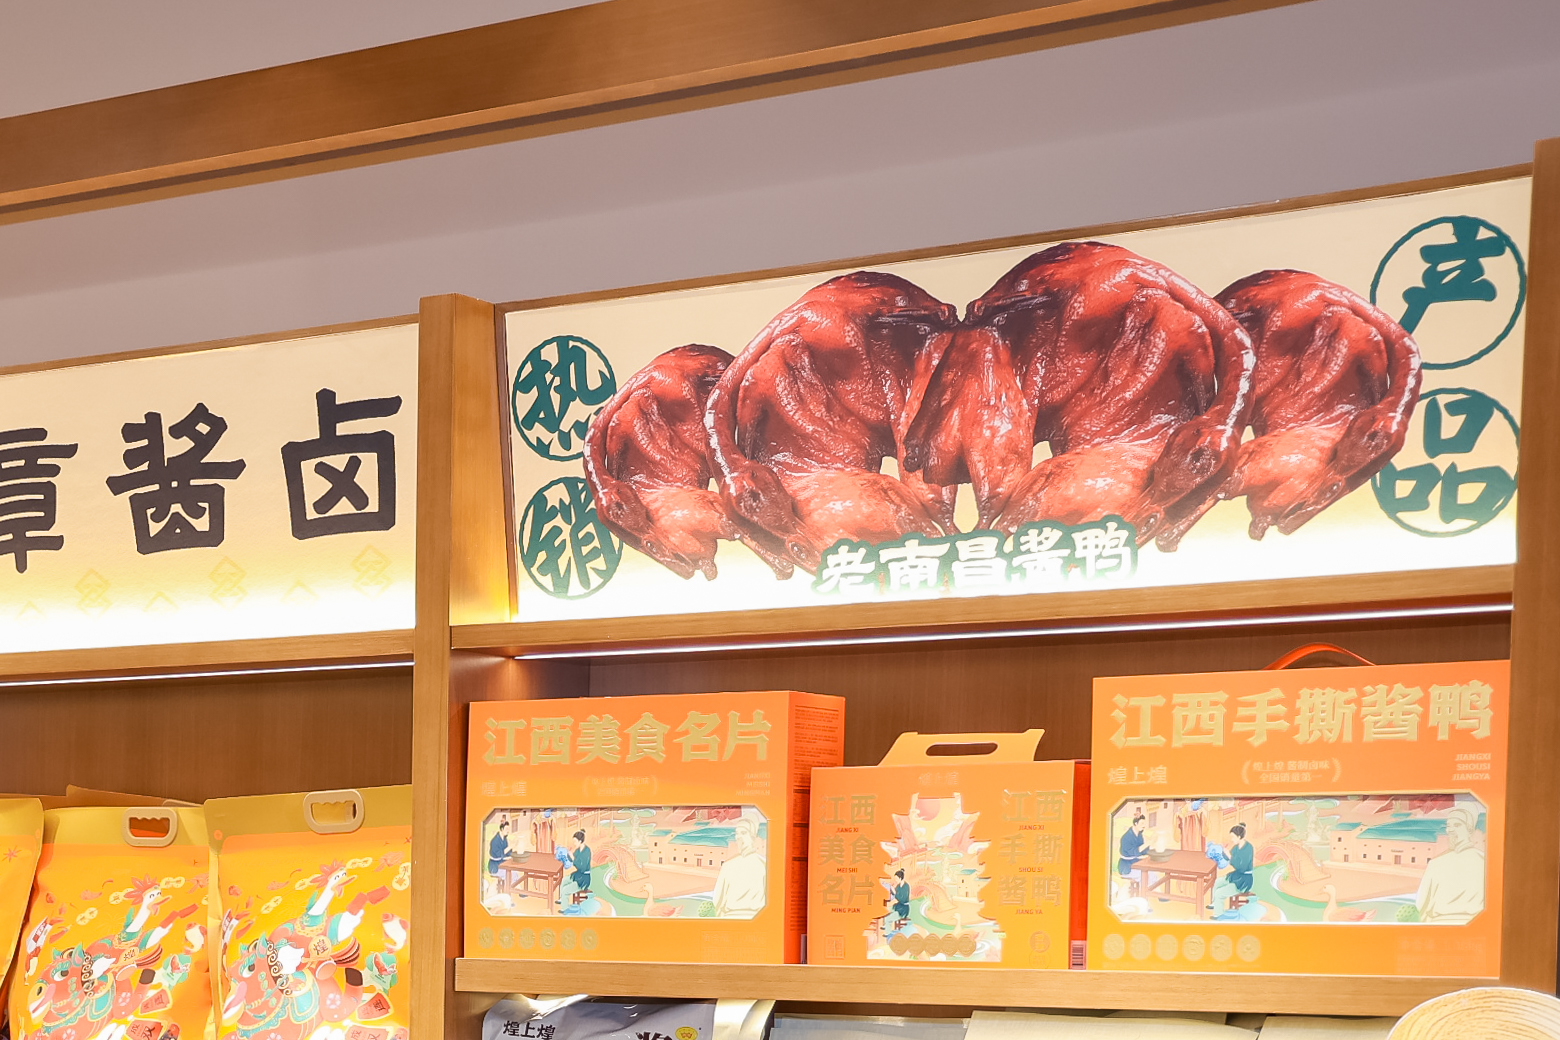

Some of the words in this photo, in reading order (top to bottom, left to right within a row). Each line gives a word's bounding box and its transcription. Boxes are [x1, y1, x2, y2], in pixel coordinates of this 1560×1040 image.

[817, 522, 1133, 594] 老南昌酱鸭
[1109, 679, 1494, 750] 江西手撕酱鸭
[483, 709, 772, 766] 江西美食名片
[1107, 765, 1168, 785] 煌上煌
[820, 794, 877, 825] 江西
[1002, 789, 1066, 822] 江西
[819, 834, 876, 865] 美食
[997, 833, 1063, 865] 手撕
[820, 875, 875, 906] 名片
[997, 875, 1063, 907] 酱鸭
[313, 938, 328, 956] 煌
[503, 1020, 556, 1040] 煌上煌
